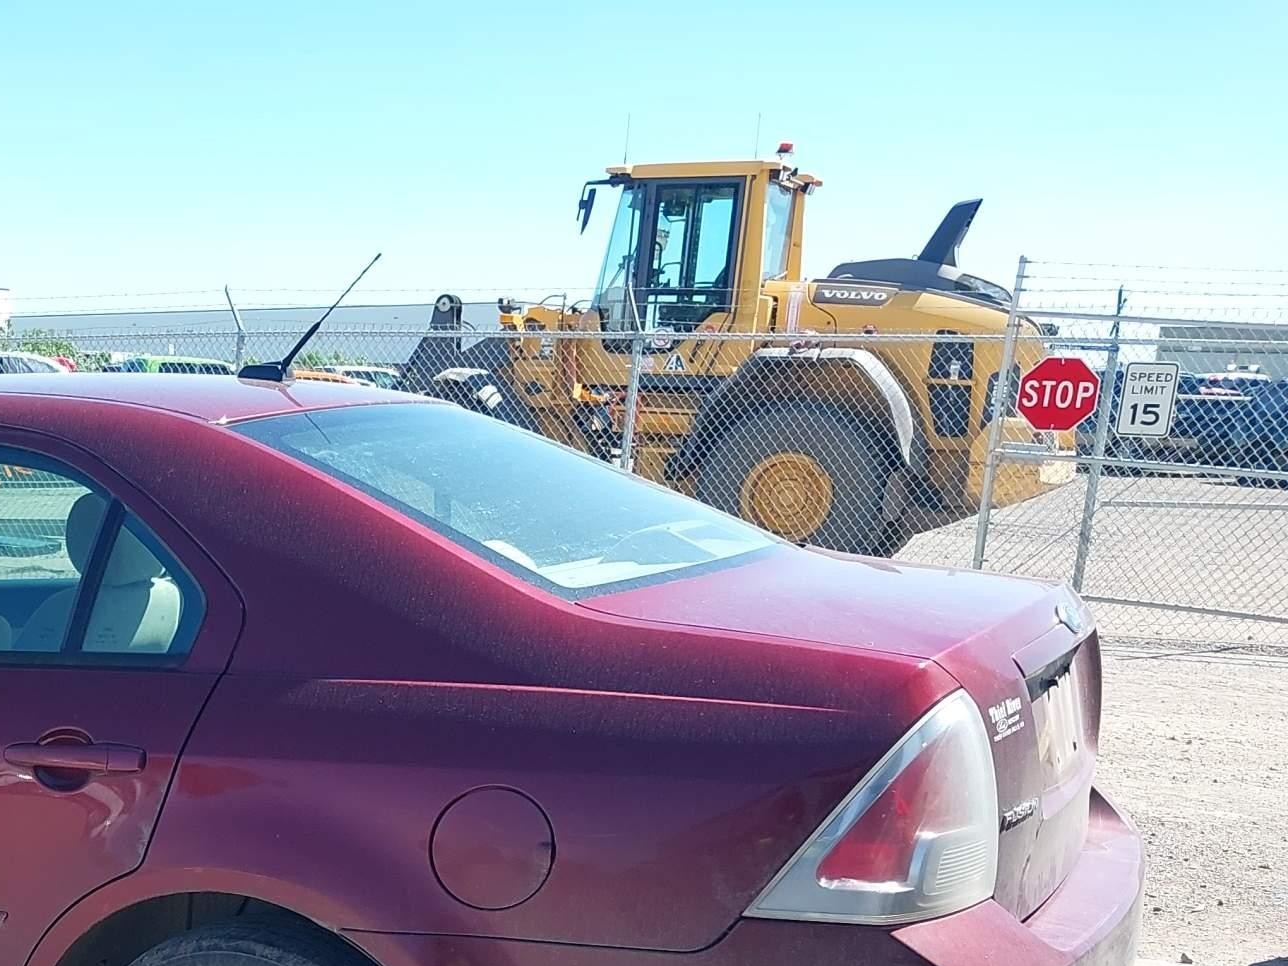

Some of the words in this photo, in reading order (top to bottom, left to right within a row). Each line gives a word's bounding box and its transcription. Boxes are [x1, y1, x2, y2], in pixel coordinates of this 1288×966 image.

[821, 289, 888, 301] VOLVO
[1129, 372, 1173, 383] SPEED
[1021, 379, 1095, 409] STOP
[1131, 385, 1168, 395] LIMIT
[1130, 403, 1161, 426] 15
